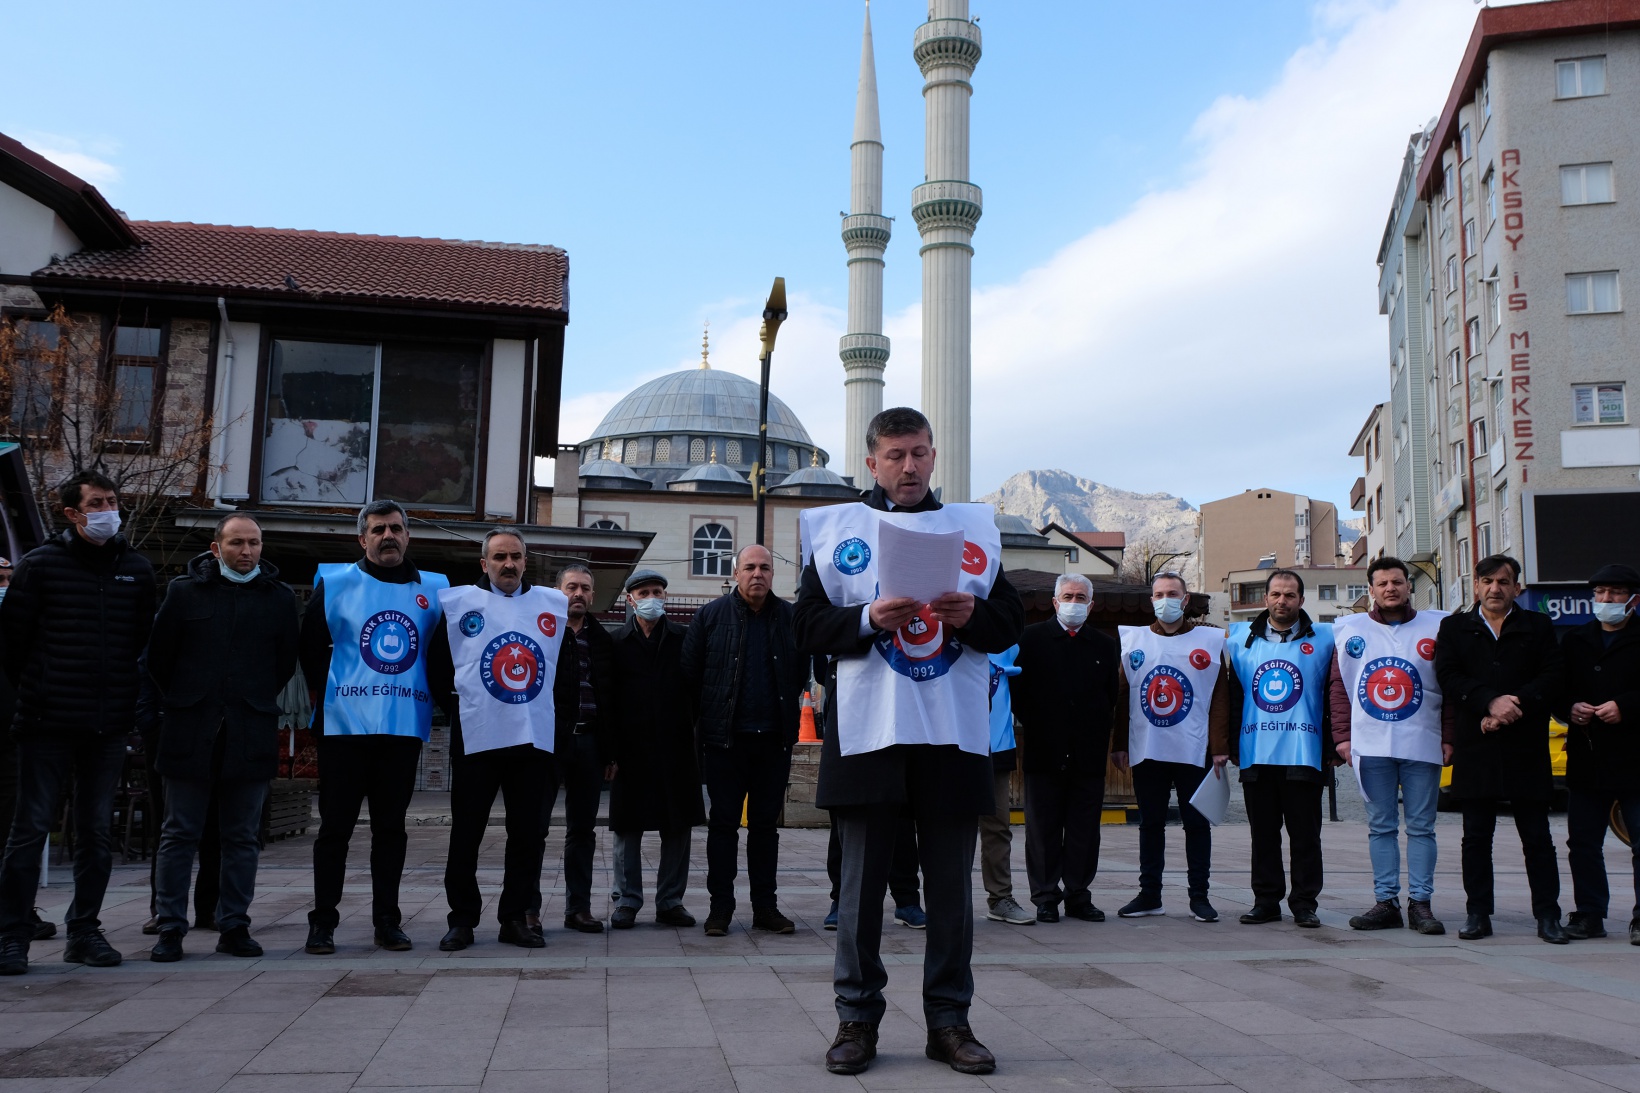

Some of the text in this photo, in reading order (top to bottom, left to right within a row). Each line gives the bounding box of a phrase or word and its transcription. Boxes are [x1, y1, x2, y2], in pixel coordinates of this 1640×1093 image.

[1501, 149, 1524, 251] AKSOY
[1510, 330, 1534, 483] MERKEZİ
[850, 566, 863, 575] 1992
[362, 611, 417, 650] TÜRK EĞİTİM-SEN
[379, 664, 400, 673] 1992
[482, 651, 494, 688] TÜRK
[492, 633, 537, 652] SAĞLIK
[535, 662, 544, 687] SEN
[908, 664, 936, 678] 1992
[1253, 660, 1301, 692] TÜRK EĞİTİM-SEN
[1369, 657, 1414, 674] SAĞLIK
[1411, 683, 1421, 705] SEN
[335, 682, 430, 704] TÜRK EĞİTİM-SEN
[1148, 667, 1185, 683] SAĞLIK
[1181, 691, 1191, 713] SEN
[1265, 704, 1284, 712] 1992
[1381, 712, 1399, 720] 1992
[1260, 720, 1319, 736] EĞİTİM-SEN
